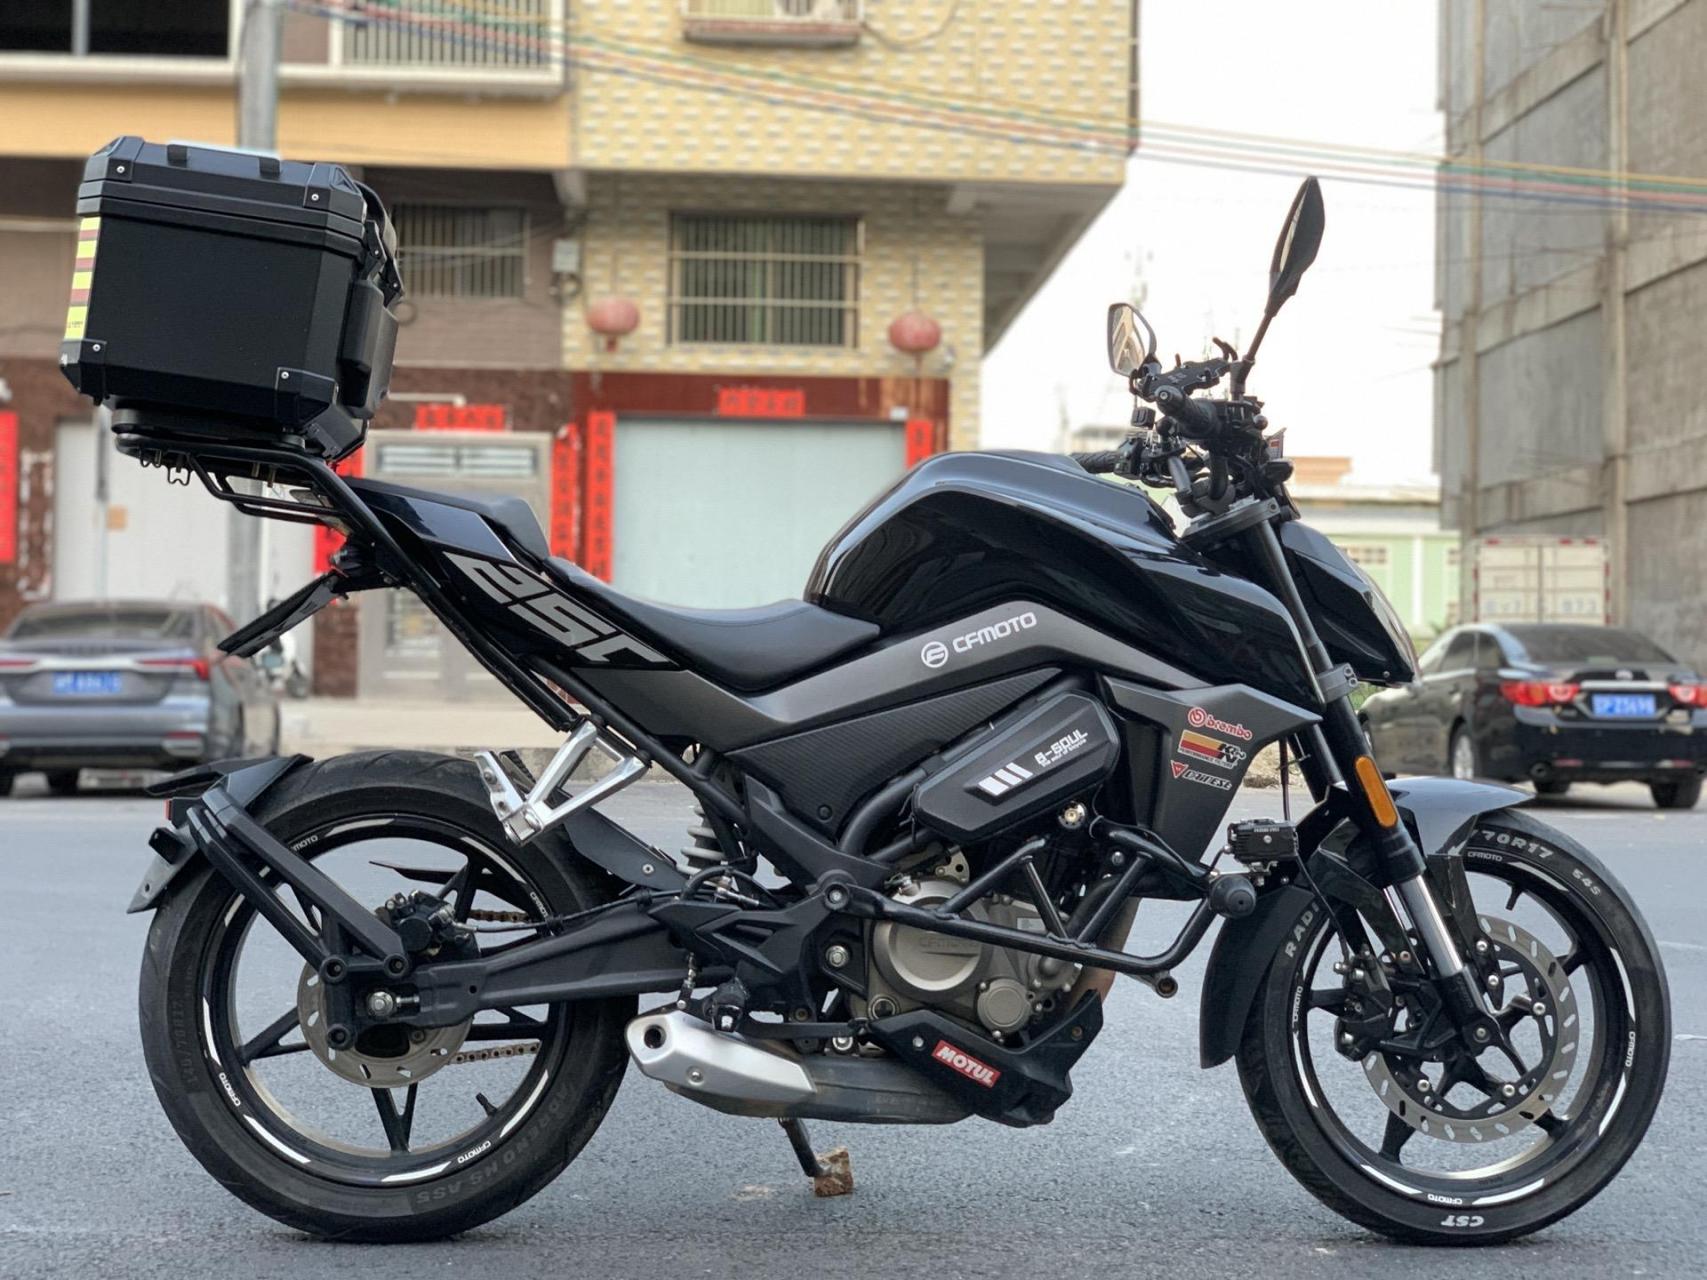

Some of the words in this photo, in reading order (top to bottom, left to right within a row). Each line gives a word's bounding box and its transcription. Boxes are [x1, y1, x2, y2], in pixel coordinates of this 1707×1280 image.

[952, 612, 1037, 653] CFMOTO
[1204, 713, 1253, 740] brembo
[1467, 851, 1503, 862] CFMOTO
[936, 1046, 994, 1083] MOTUL
[457, 1140, 491, 1164] CFMOTO
[1427, 1193, 1463, 1205] CFMOTO
[1440, 1215, 1485, 1227] CST
